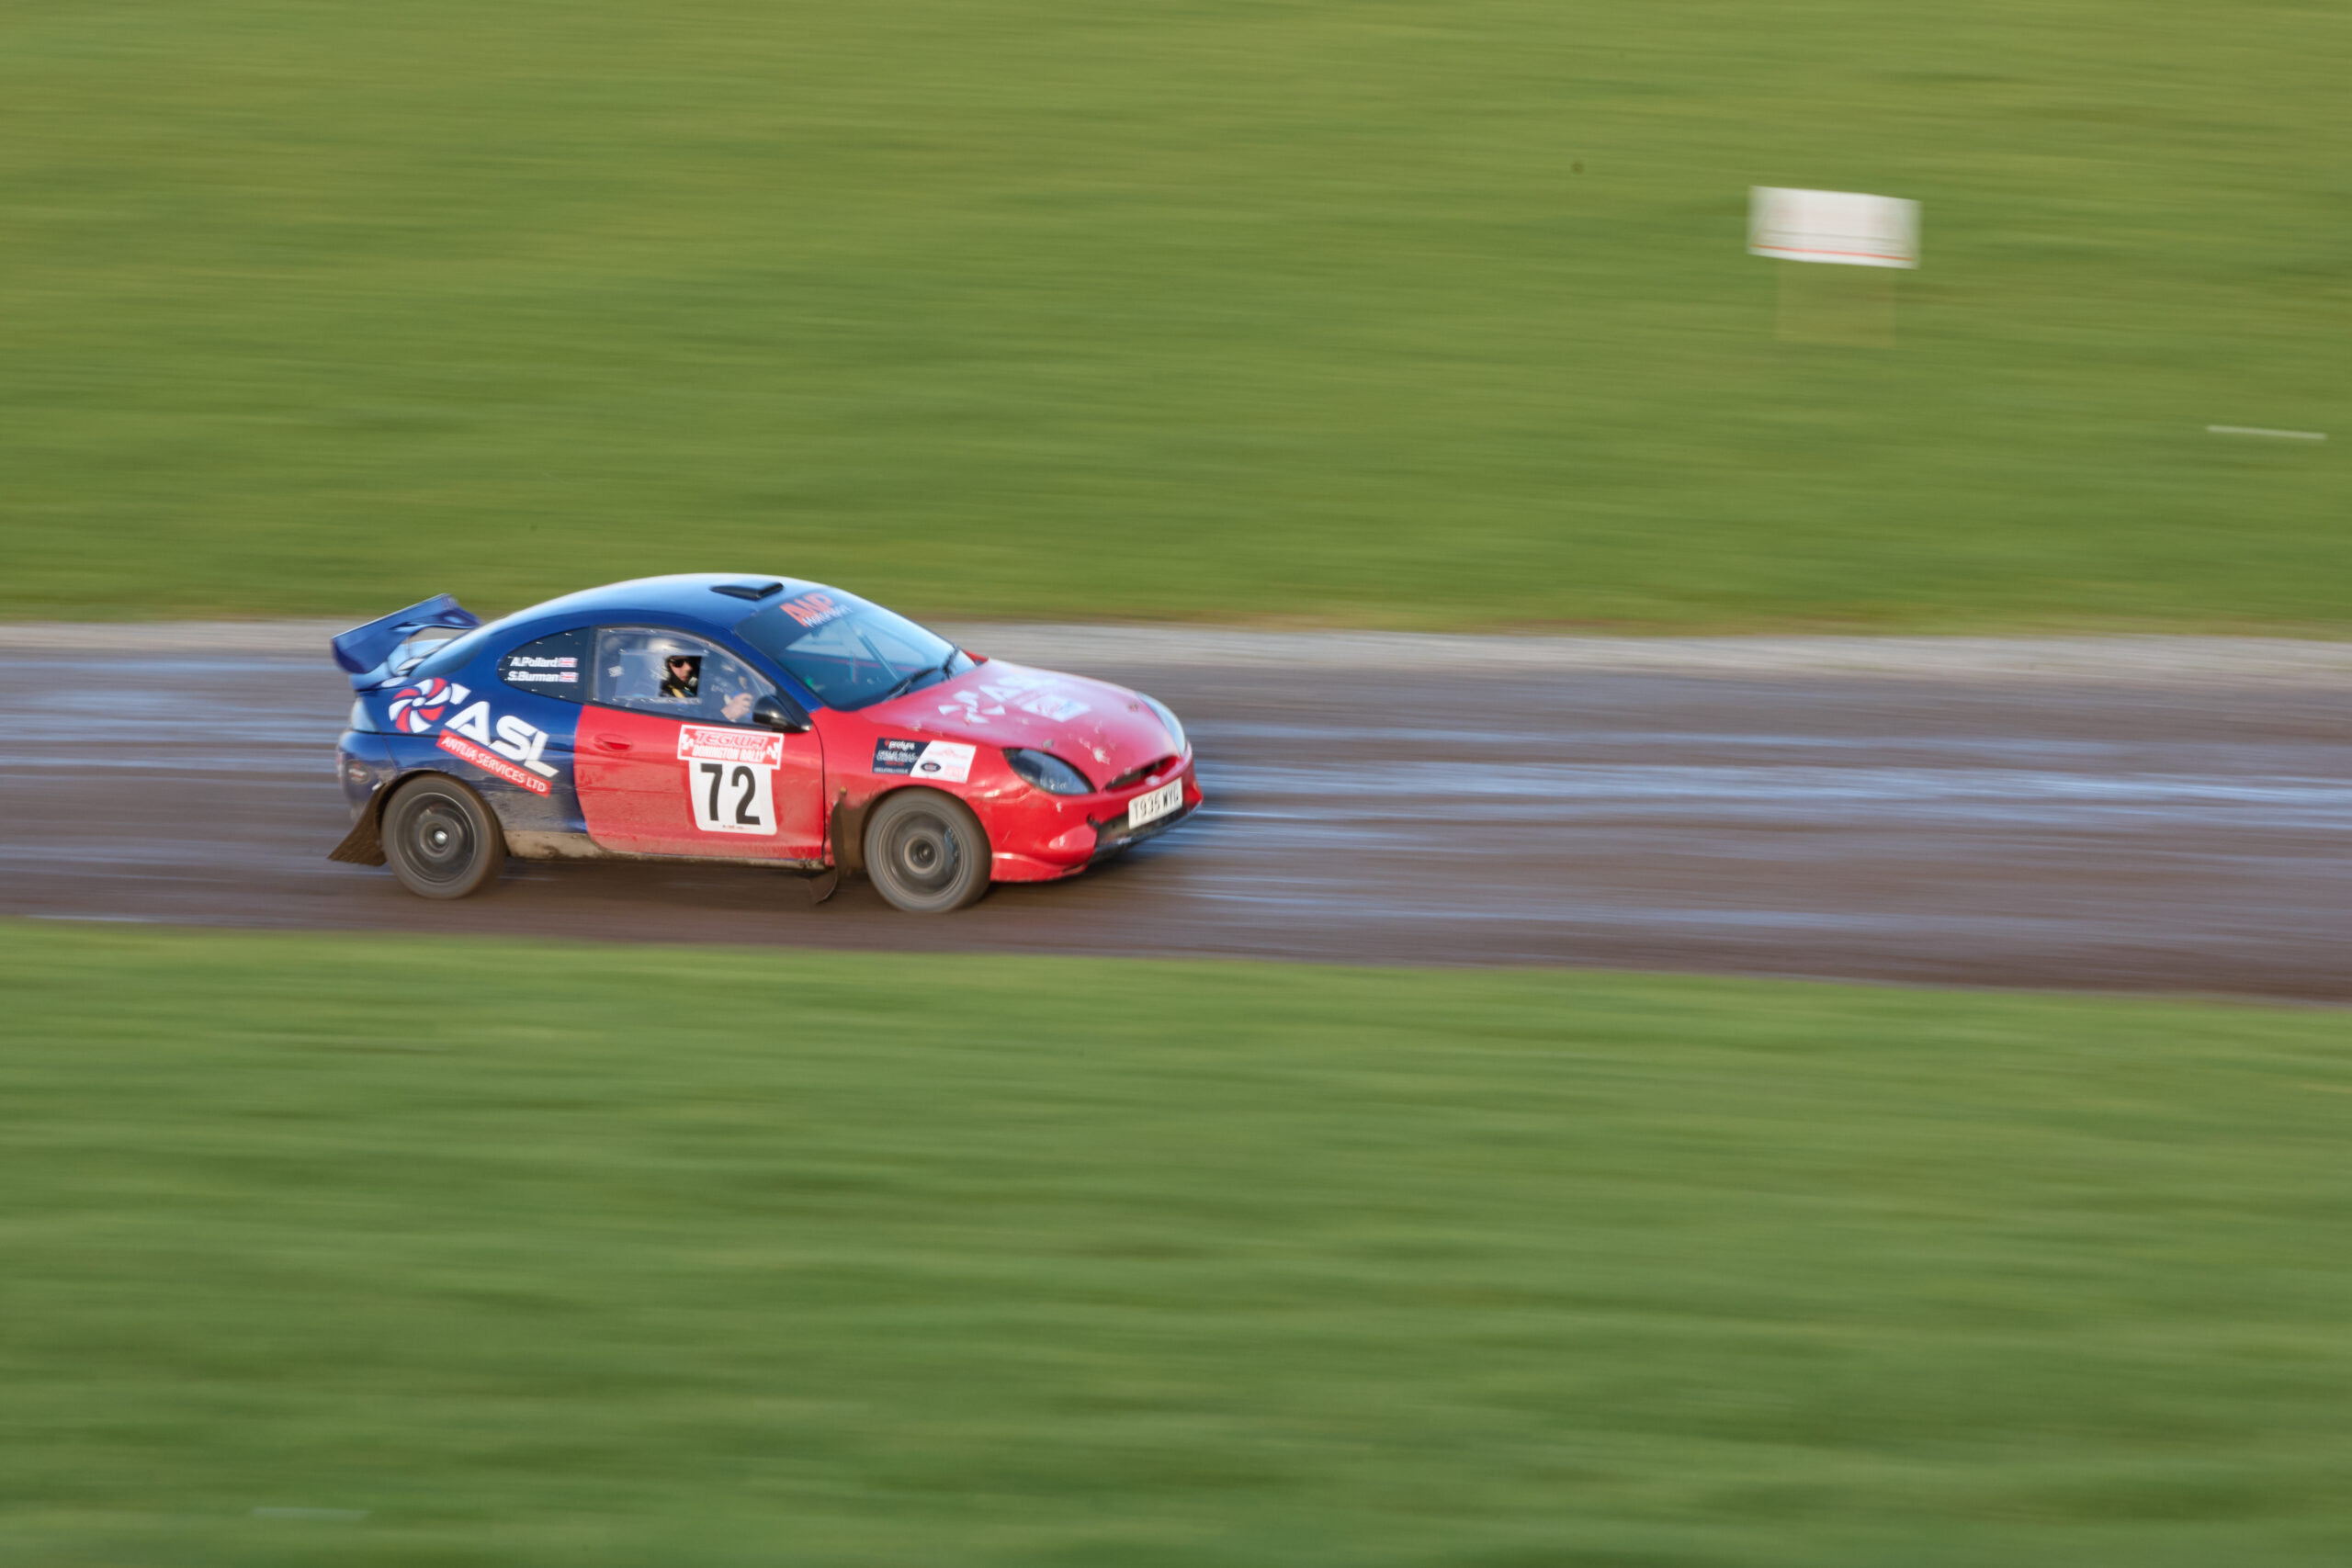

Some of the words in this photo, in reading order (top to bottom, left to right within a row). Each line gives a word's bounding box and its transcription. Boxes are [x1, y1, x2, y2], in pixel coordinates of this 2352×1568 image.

[510, 657, 559, 667] A.Pollard
[507, 671, 559, 682] S.Burman
[445, 701, 560, 778] ASL
[694, 730, 768, 750] TEGIWA
[441, 736, 479, 761] ANTLIA
[476, 752, 526, 784] SERVICES
[526, 777, 548, 793] LTD
[739, 749, 767, 763] RALLY
[700, 762, 761, 826] 72
